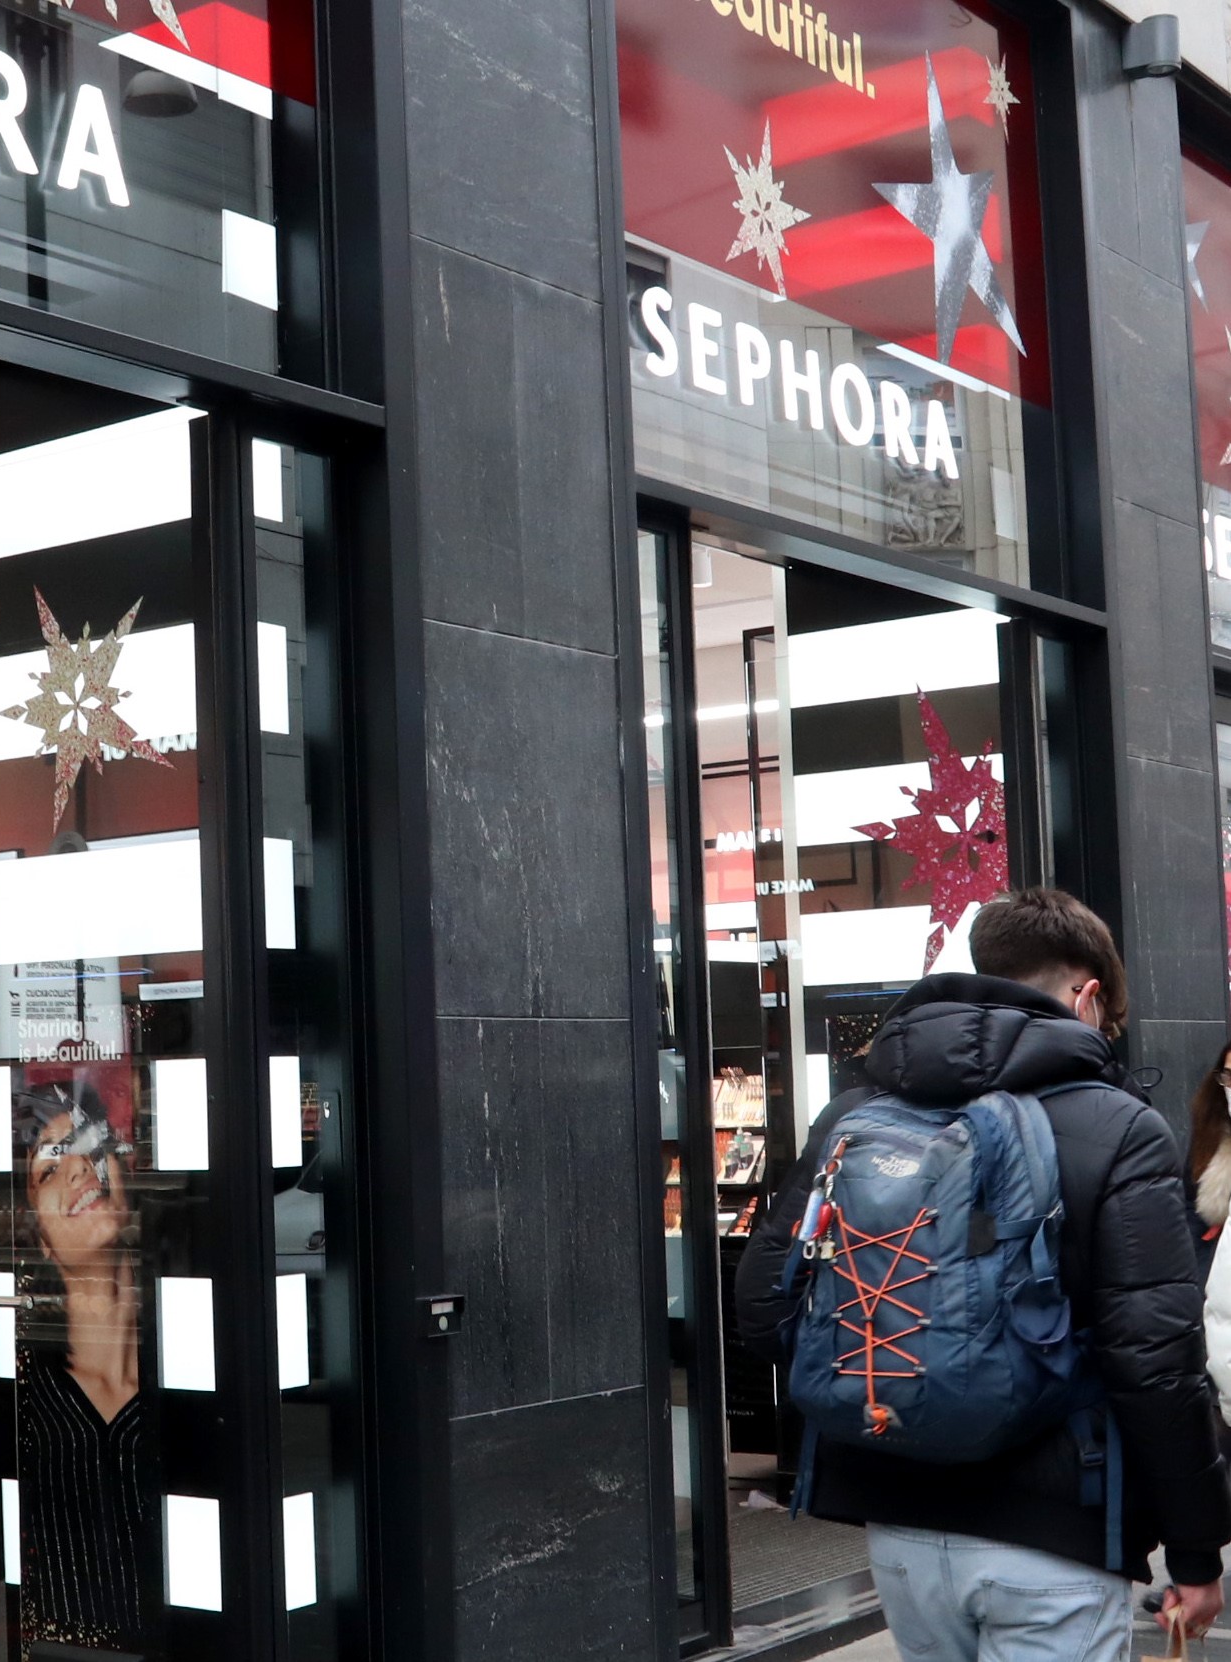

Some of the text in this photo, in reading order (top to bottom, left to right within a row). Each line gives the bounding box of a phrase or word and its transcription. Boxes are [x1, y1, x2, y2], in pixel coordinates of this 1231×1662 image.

[709, 0, 875, 99] autiful.
[641, 286, 959, 479] SEPHORA
[18, 1019, 83, 1041] Sharing
[19, 1040, 121, 1063] is beautiful.
